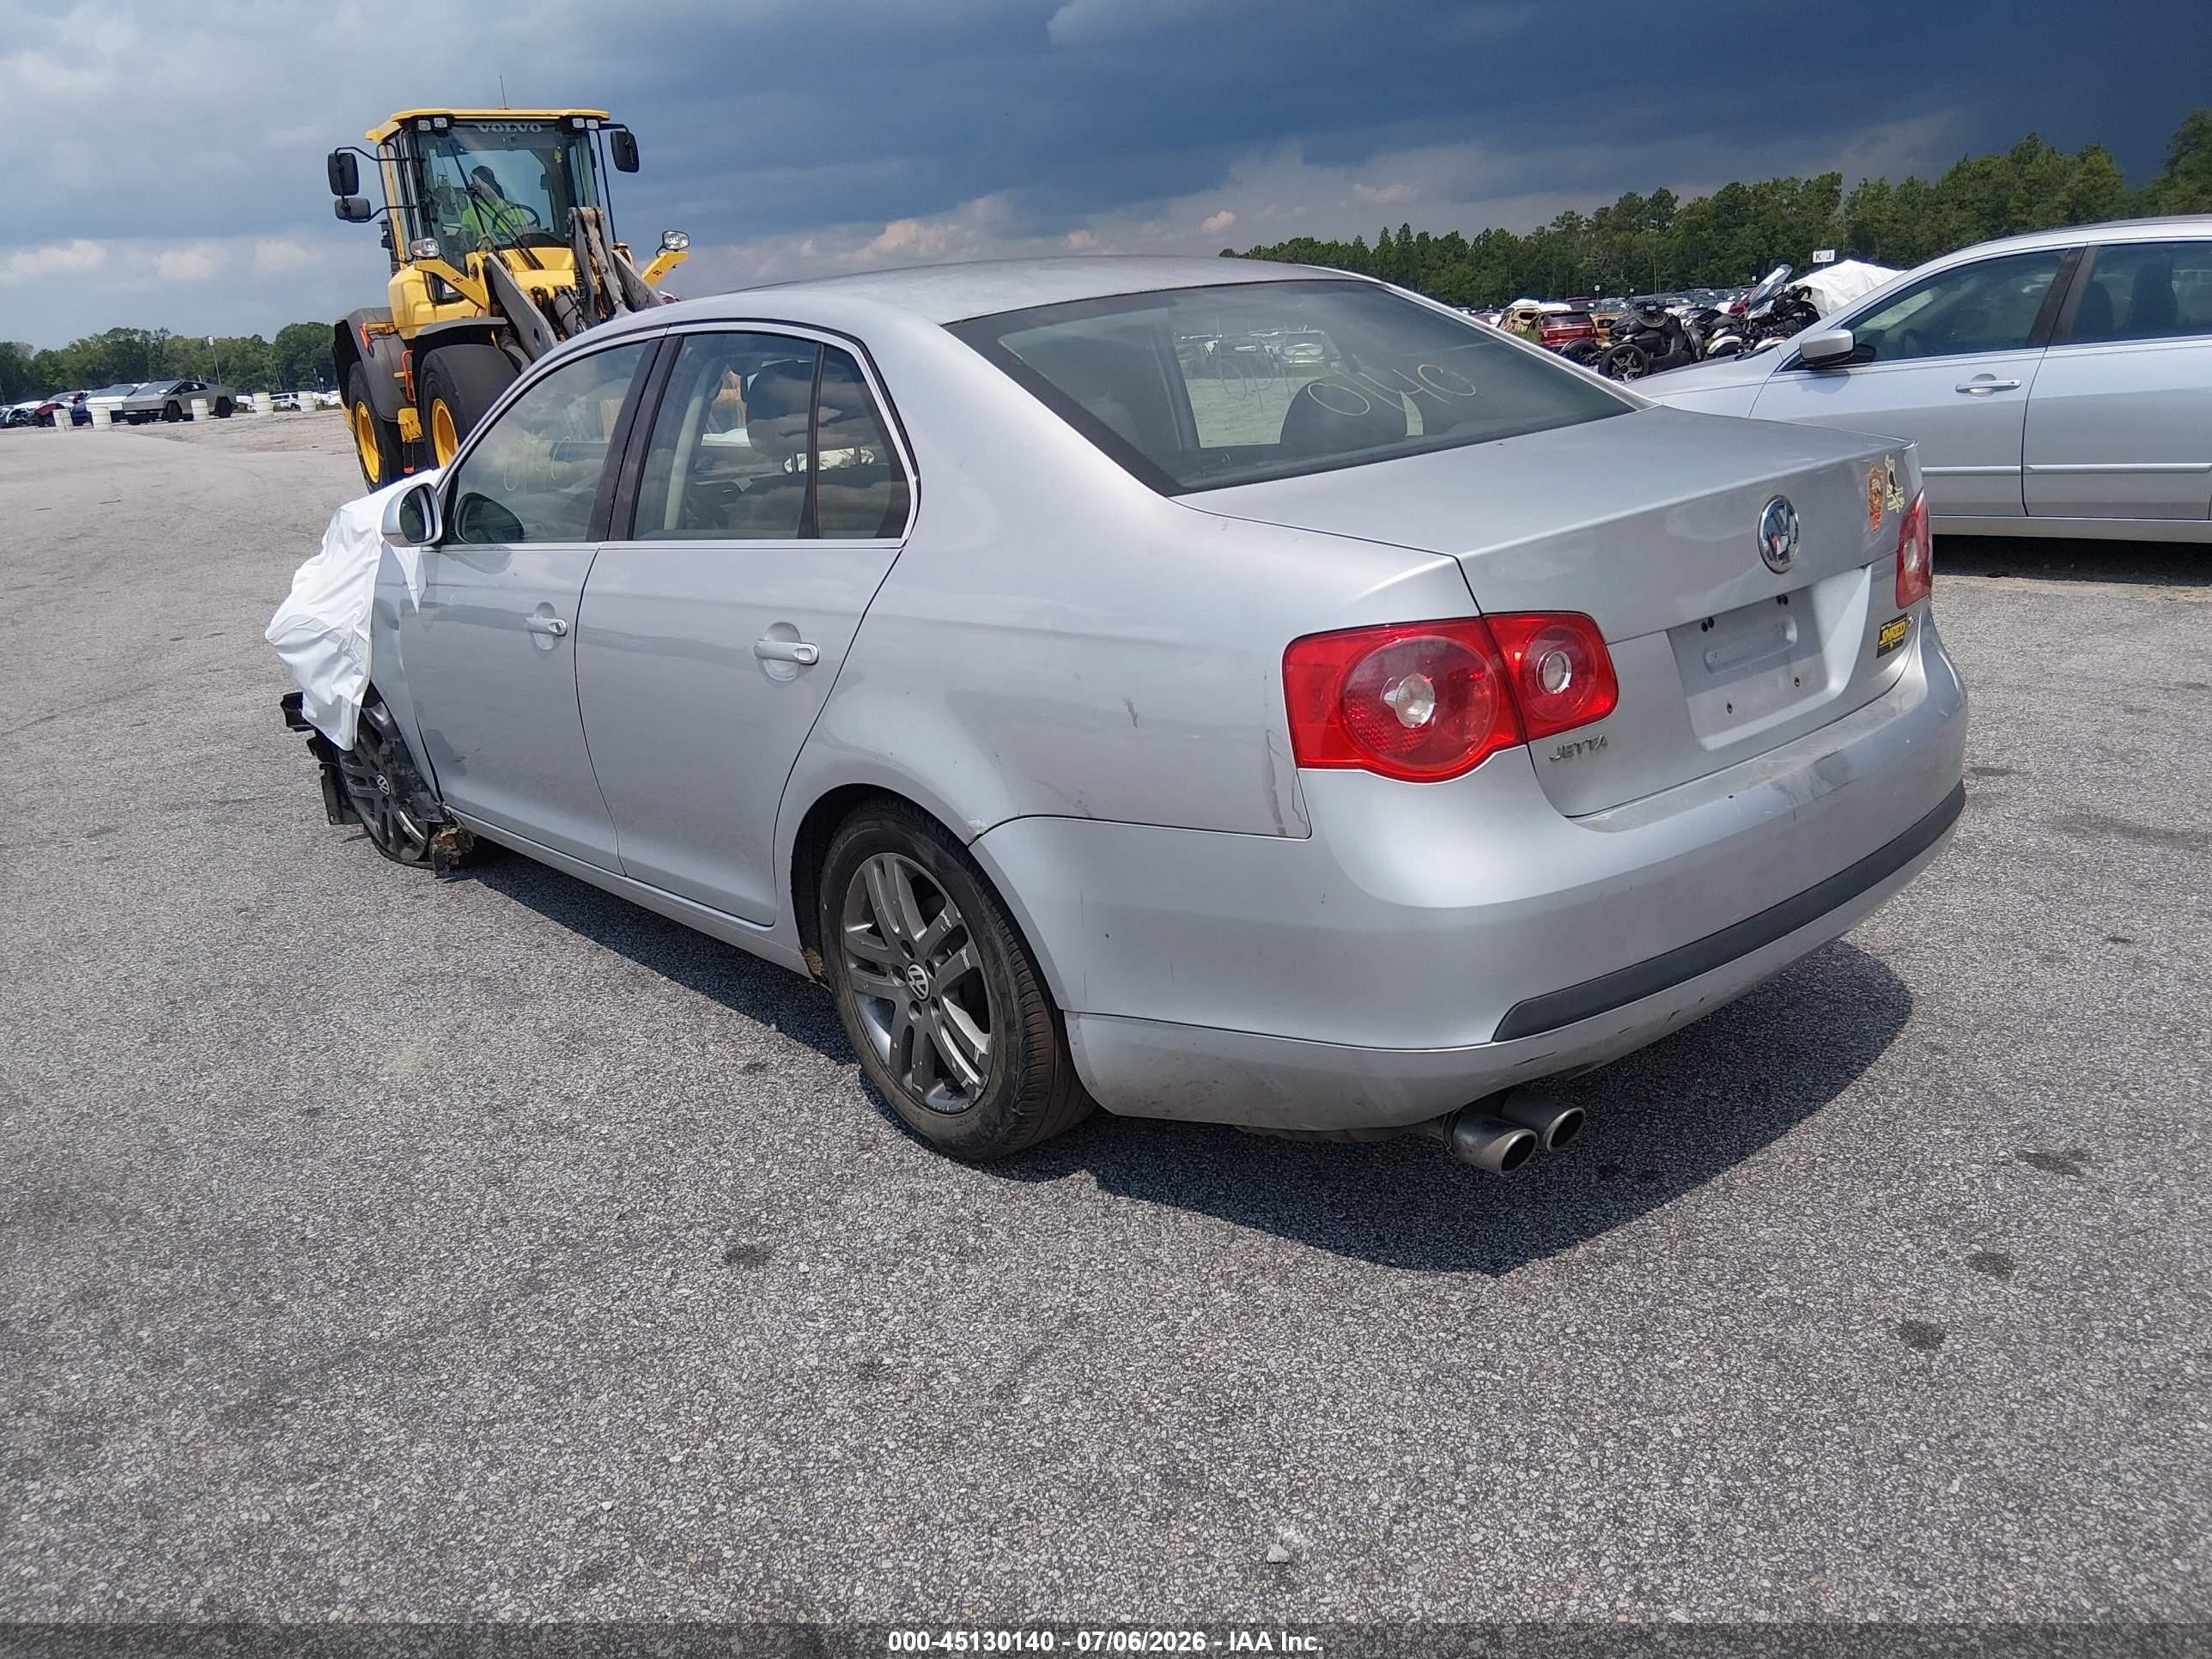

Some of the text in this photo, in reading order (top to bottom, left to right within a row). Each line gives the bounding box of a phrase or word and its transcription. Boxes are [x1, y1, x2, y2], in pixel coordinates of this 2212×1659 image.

[474, 123, 543, 133] VOLVO
[1815, 251, 1832, 261] K J
[1549, 734, 1608, 762] JETTA
